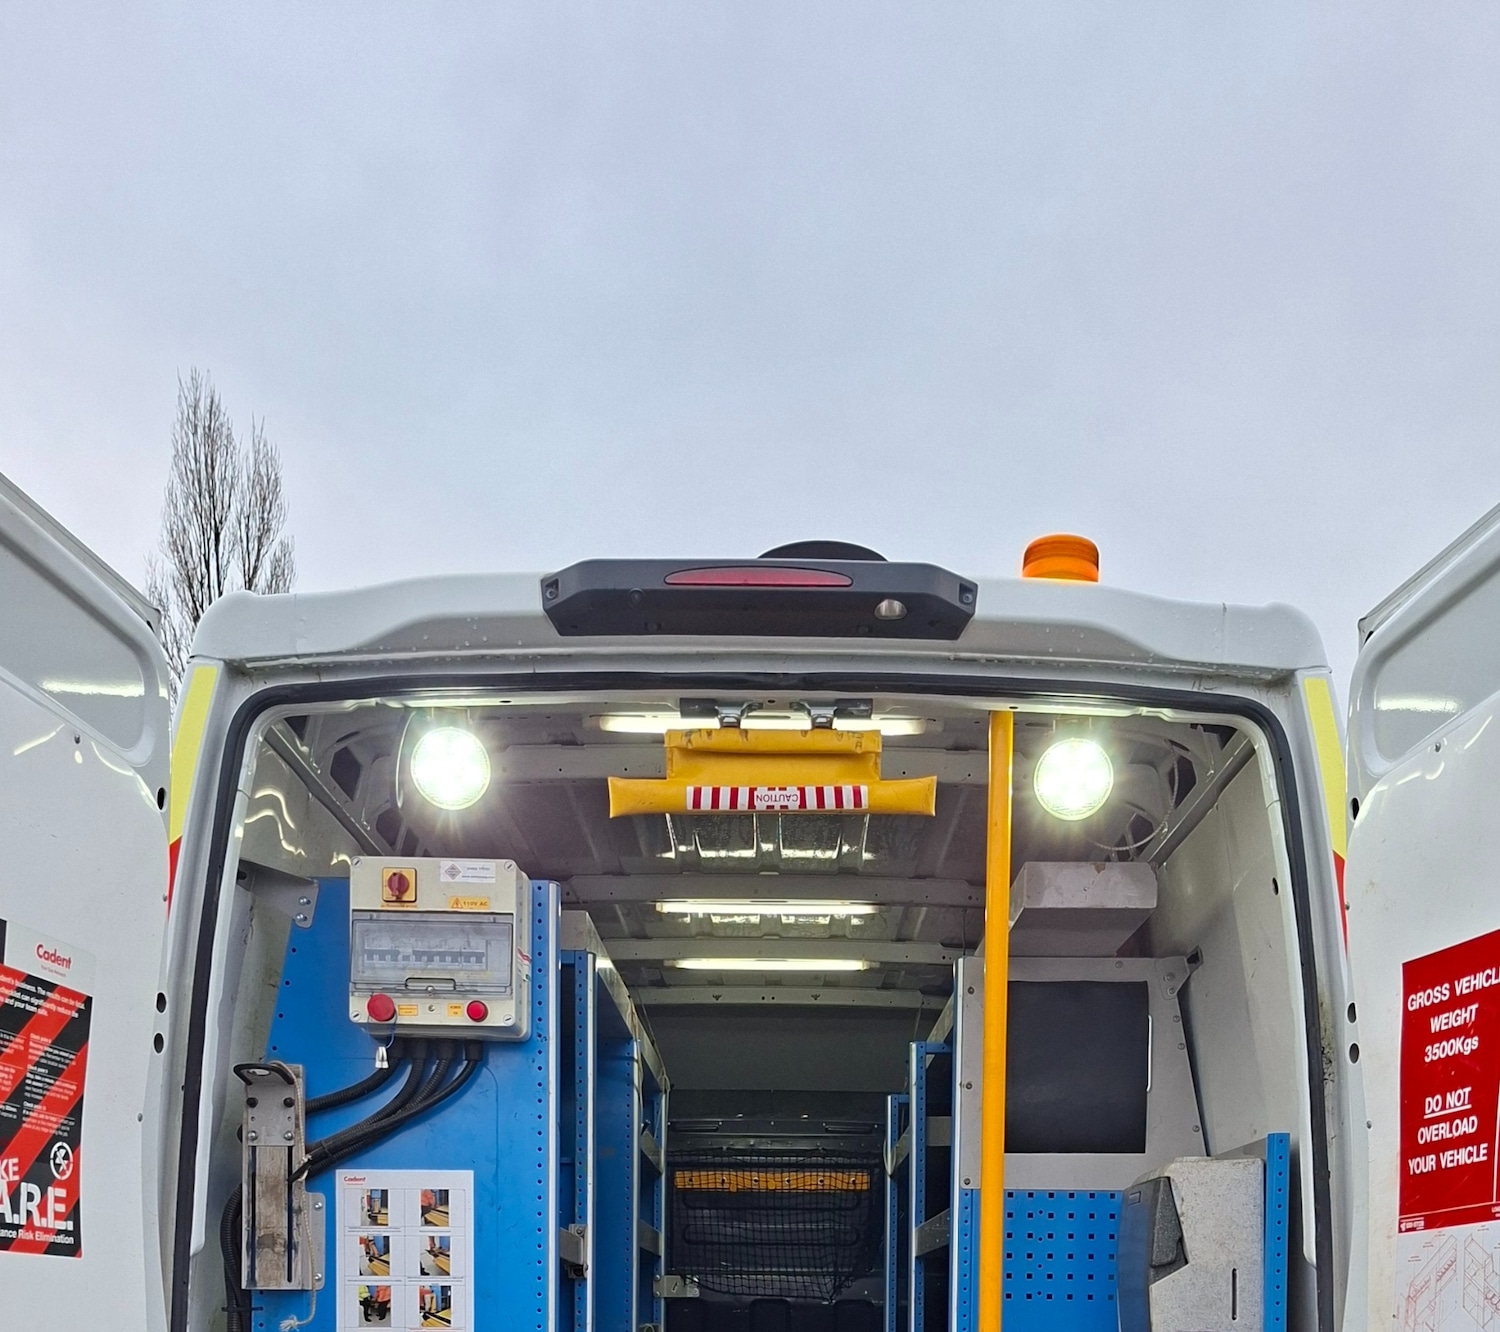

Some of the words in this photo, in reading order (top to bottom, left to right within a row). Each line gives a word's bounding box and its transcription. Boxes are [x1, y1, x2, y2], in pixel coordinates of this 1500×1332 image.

[756, 793, 799, 802] CAUTION
[36, 944, 72, 969] Cadent
[1408, 983, 1450, 1011] GROSS
[1430, 1003, 1479, 1034] WEIGHT
[1424, 1035, 1479, 1063] 3500Kgs
[1425, 1096, 1442, 1115] DO
[1445, 1087, 1472, 1110] NOT
[1417, 1115, 1478, 1145] OVERLOAD
[1408, 1155, 1436, 1176] YOUR
[1440, 1143, 1488, 1169] VEHICLE
[18, 1229, 34, 1241] Risk
[35, 1231, 74, 1244] Elimination
